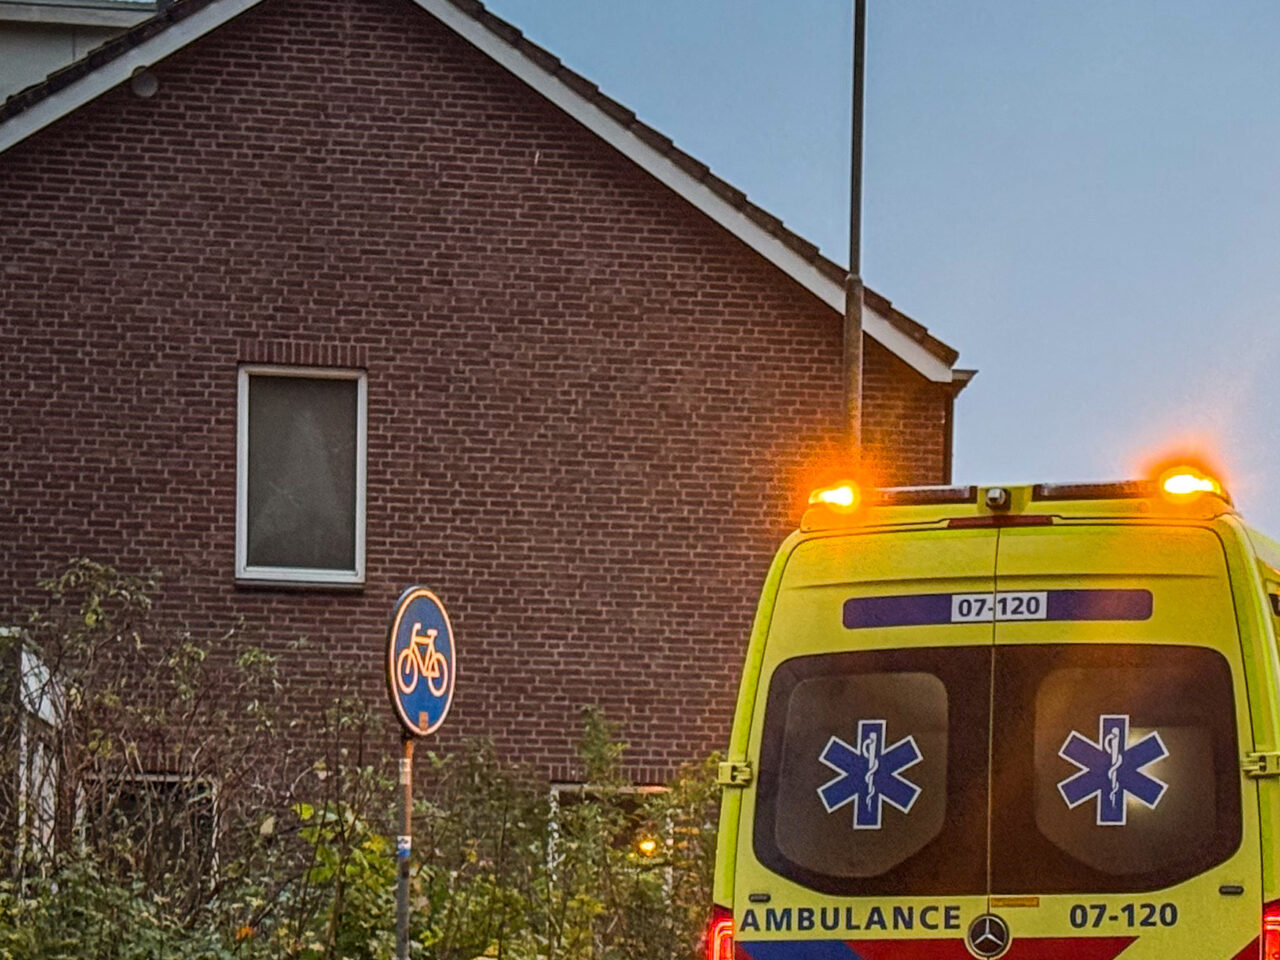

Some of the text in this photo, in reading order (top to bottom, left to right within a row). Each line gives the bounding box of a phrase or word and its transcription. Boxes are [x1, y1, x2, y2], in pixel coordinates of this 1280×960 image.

[958, 597, 1040, 617] 07-120
[739, 906, 961, 932] AMBULANCE
[1069, 903, 1178, 929] 07-120
